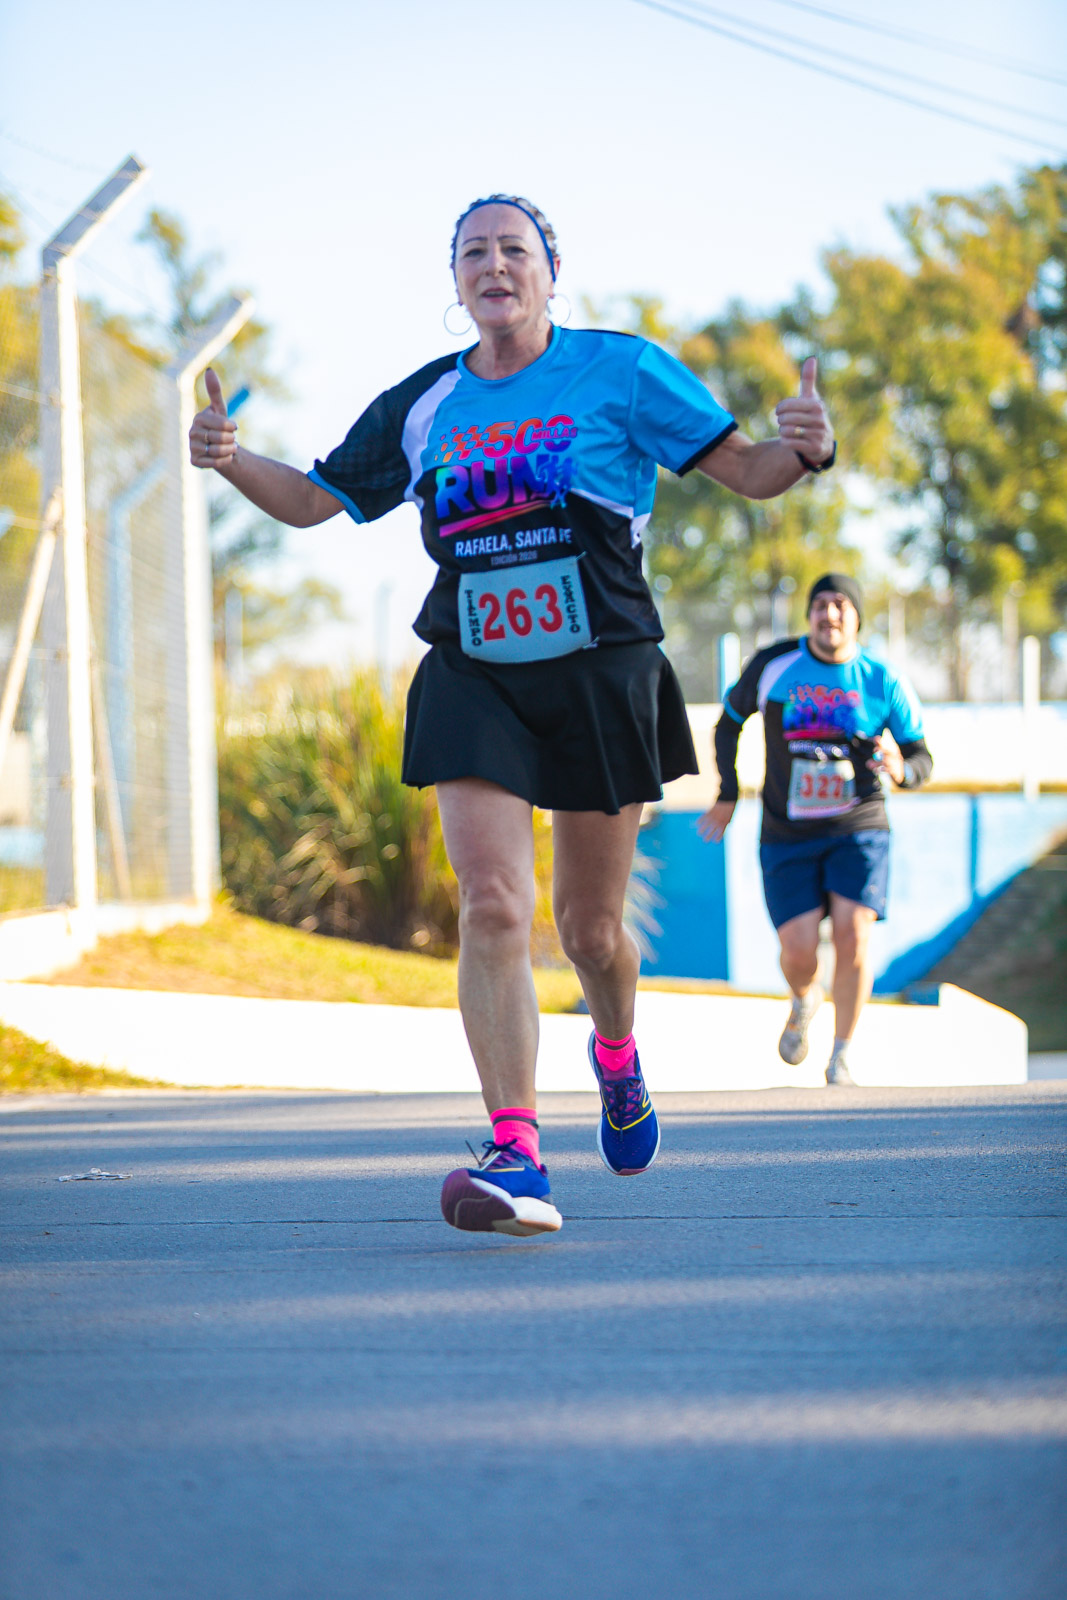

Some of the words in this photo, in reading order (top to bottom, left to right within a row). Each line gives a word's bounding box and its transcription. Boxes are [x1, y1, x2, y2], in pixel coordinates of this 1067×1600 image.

[531, 426, 579, 441] MILLAS
[436, 454, 556, 519] RUN
[454, 533, 512, 557] RAFAELA,
[515, 526, 557, 549] SANTA
[464, 589, 482, 646] TIEMPO
[478, 583, 563, 641] 263
[561, 575, 581, 633] EXACTO
[802, 773, 844, 799] 327
